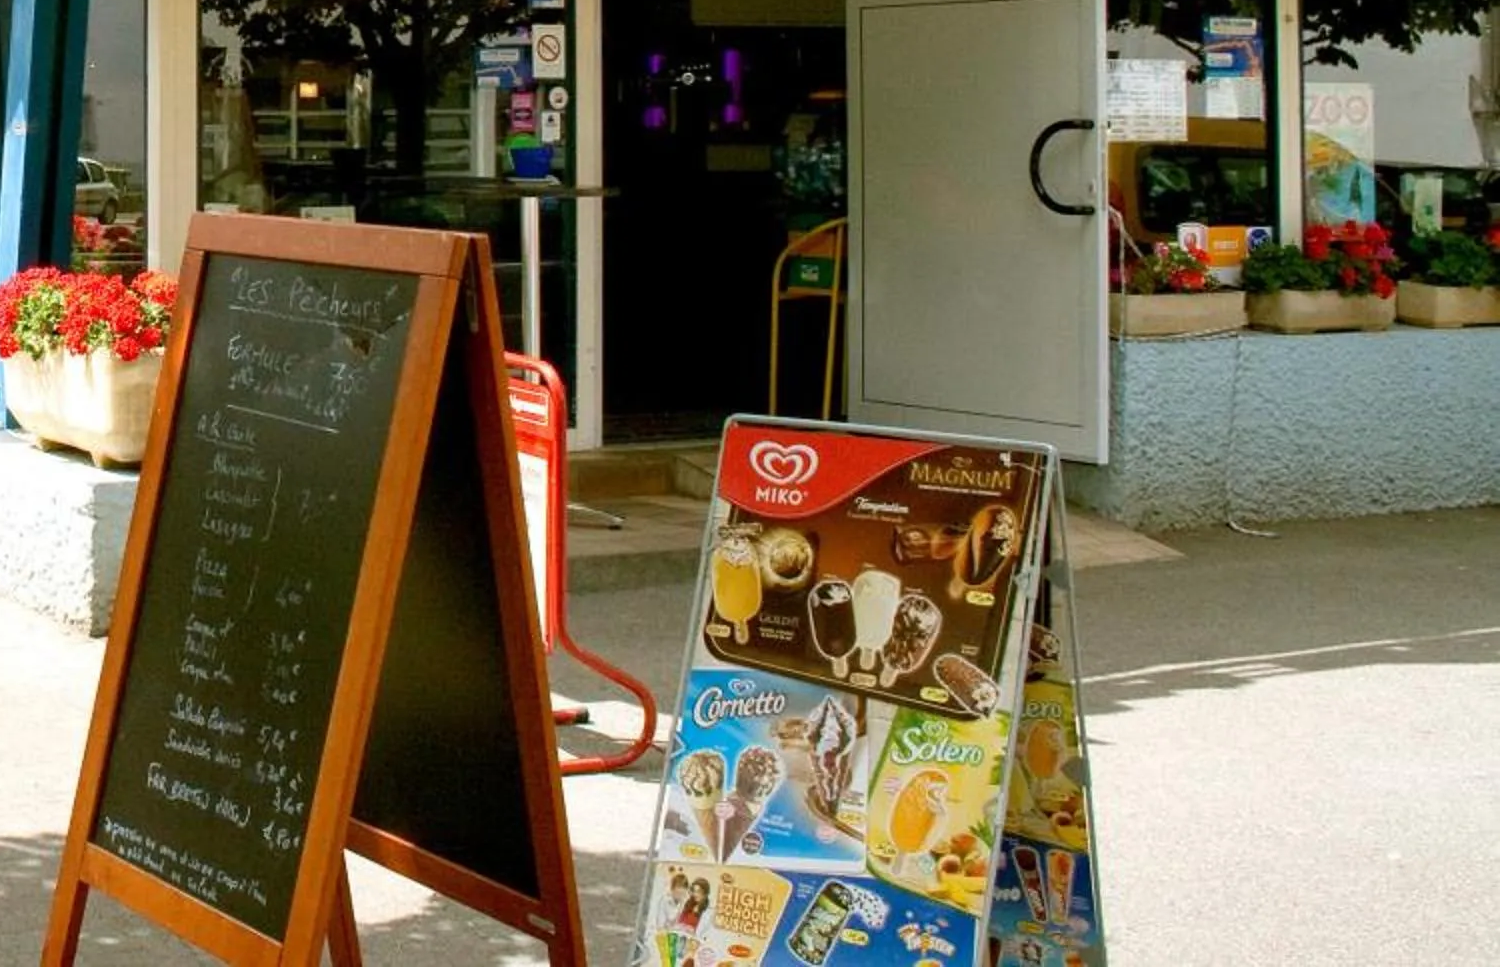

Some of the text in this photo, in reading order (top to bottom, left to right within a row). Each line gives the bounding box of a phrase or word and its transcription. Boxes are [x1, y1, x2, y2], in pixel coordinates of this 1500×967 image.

[909, 461, 1015, 490] MAGNUM
[755, 485, 803, 506] MIKO
[694, 686, 786, 728] Cornetto
[891, 725, 985, 767] Solero
[718, 888, 771, 911] HIGH
